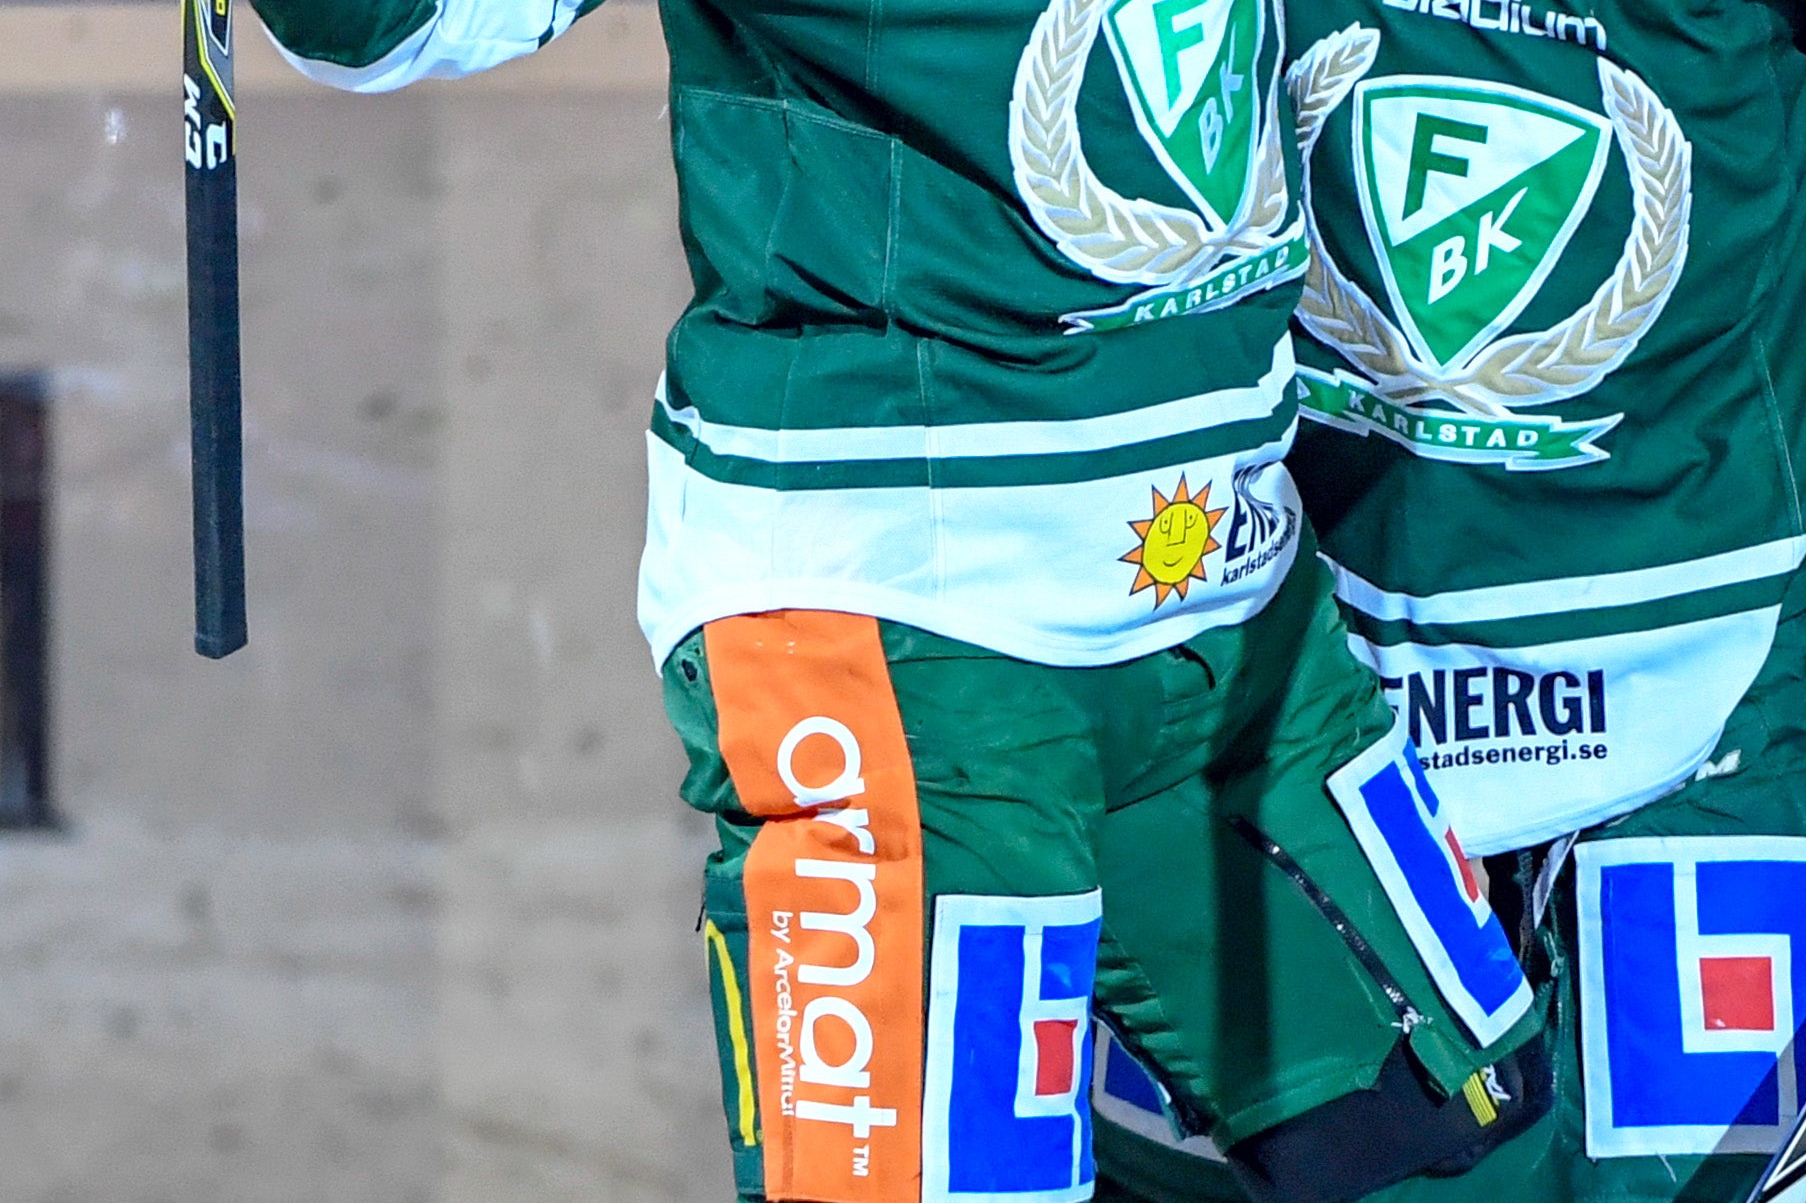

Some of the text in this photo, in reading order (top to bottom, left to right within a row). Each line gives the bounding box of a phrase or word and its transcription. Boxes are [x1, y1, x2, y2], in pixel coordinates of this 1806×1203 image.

[1133, 244, 1290, 323] KARLSTAD
[1348, 387, 1540, 448] KARLSTAD
[1418, 739, 1609, 771] stadsenergi.se
[770, 910, 793, 943] by
